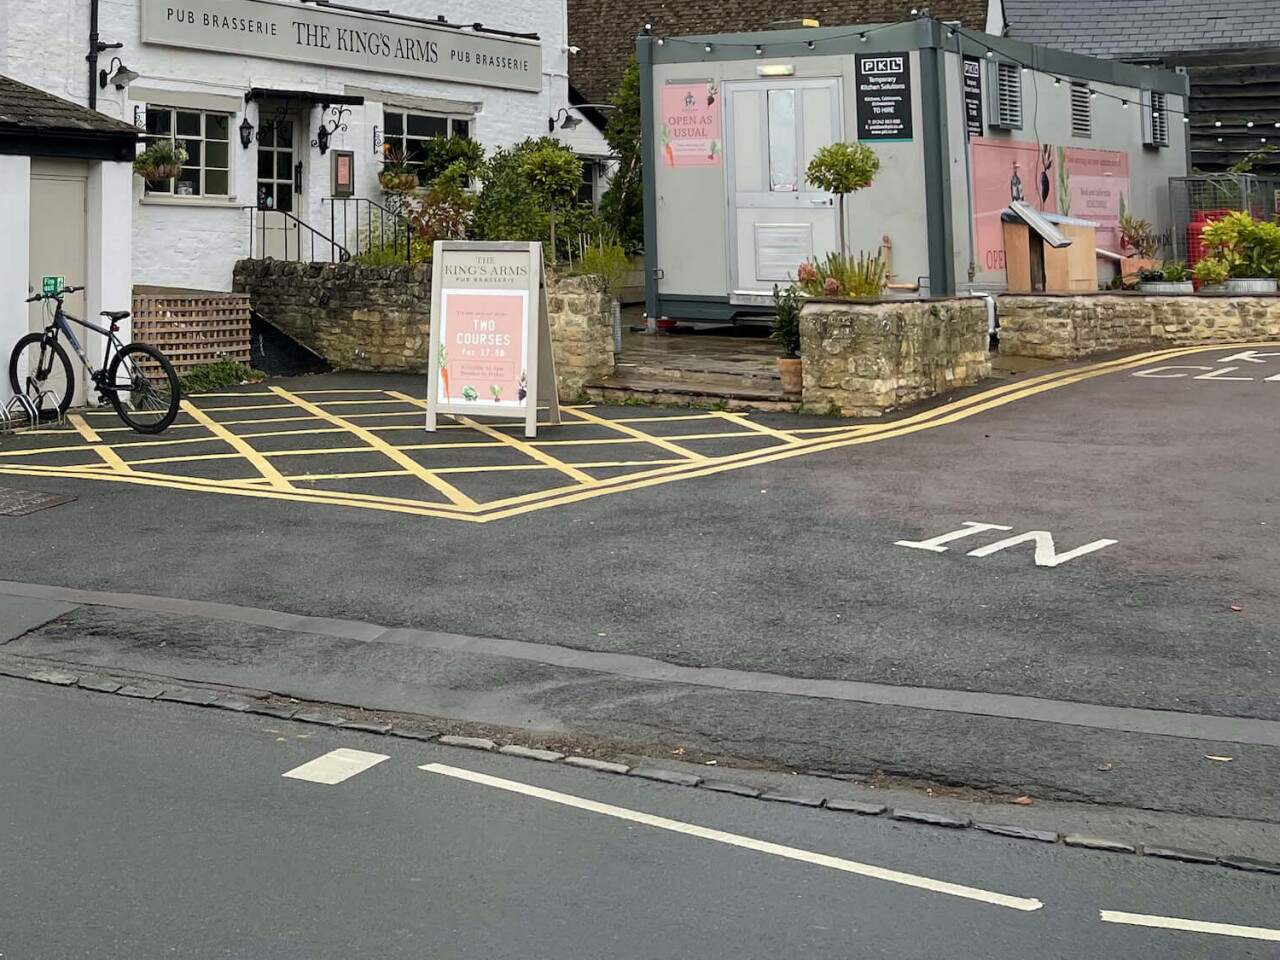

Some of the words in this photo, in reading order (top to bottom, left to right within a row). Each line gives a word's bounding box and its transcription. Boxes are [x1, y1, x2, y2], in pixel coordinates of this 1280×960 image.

[167, 7, 195, 24] PUB
[203, 13, 277, 36] BRASSERIE
[292, 21, 331, 49] THE
[336, 28, 391, 57] KING'S
[394, 38, 439, 64] ARMS
[451, 49, 471, 64] PUB
[476, 54, 529, 72] BRASSERIE
[863, 59, 901, 72] PKL
[668, 115, 697, 125] OPEN
[700, 115, 713, 125] AS
[674, 128, 708, 137] USUAL
[475, 256, 496, 264] THE
[986, 250, 1007, 270] OPE
[445, 265, 487, 276] KING'S
[490, 265, 528, 276] ARMS
[473, 319, 496, 331] TWO
[456, 332, 511, 346] COURSES
[1132, 365, 1280, 382] CL
[894, 521, 1119, 567] IN
